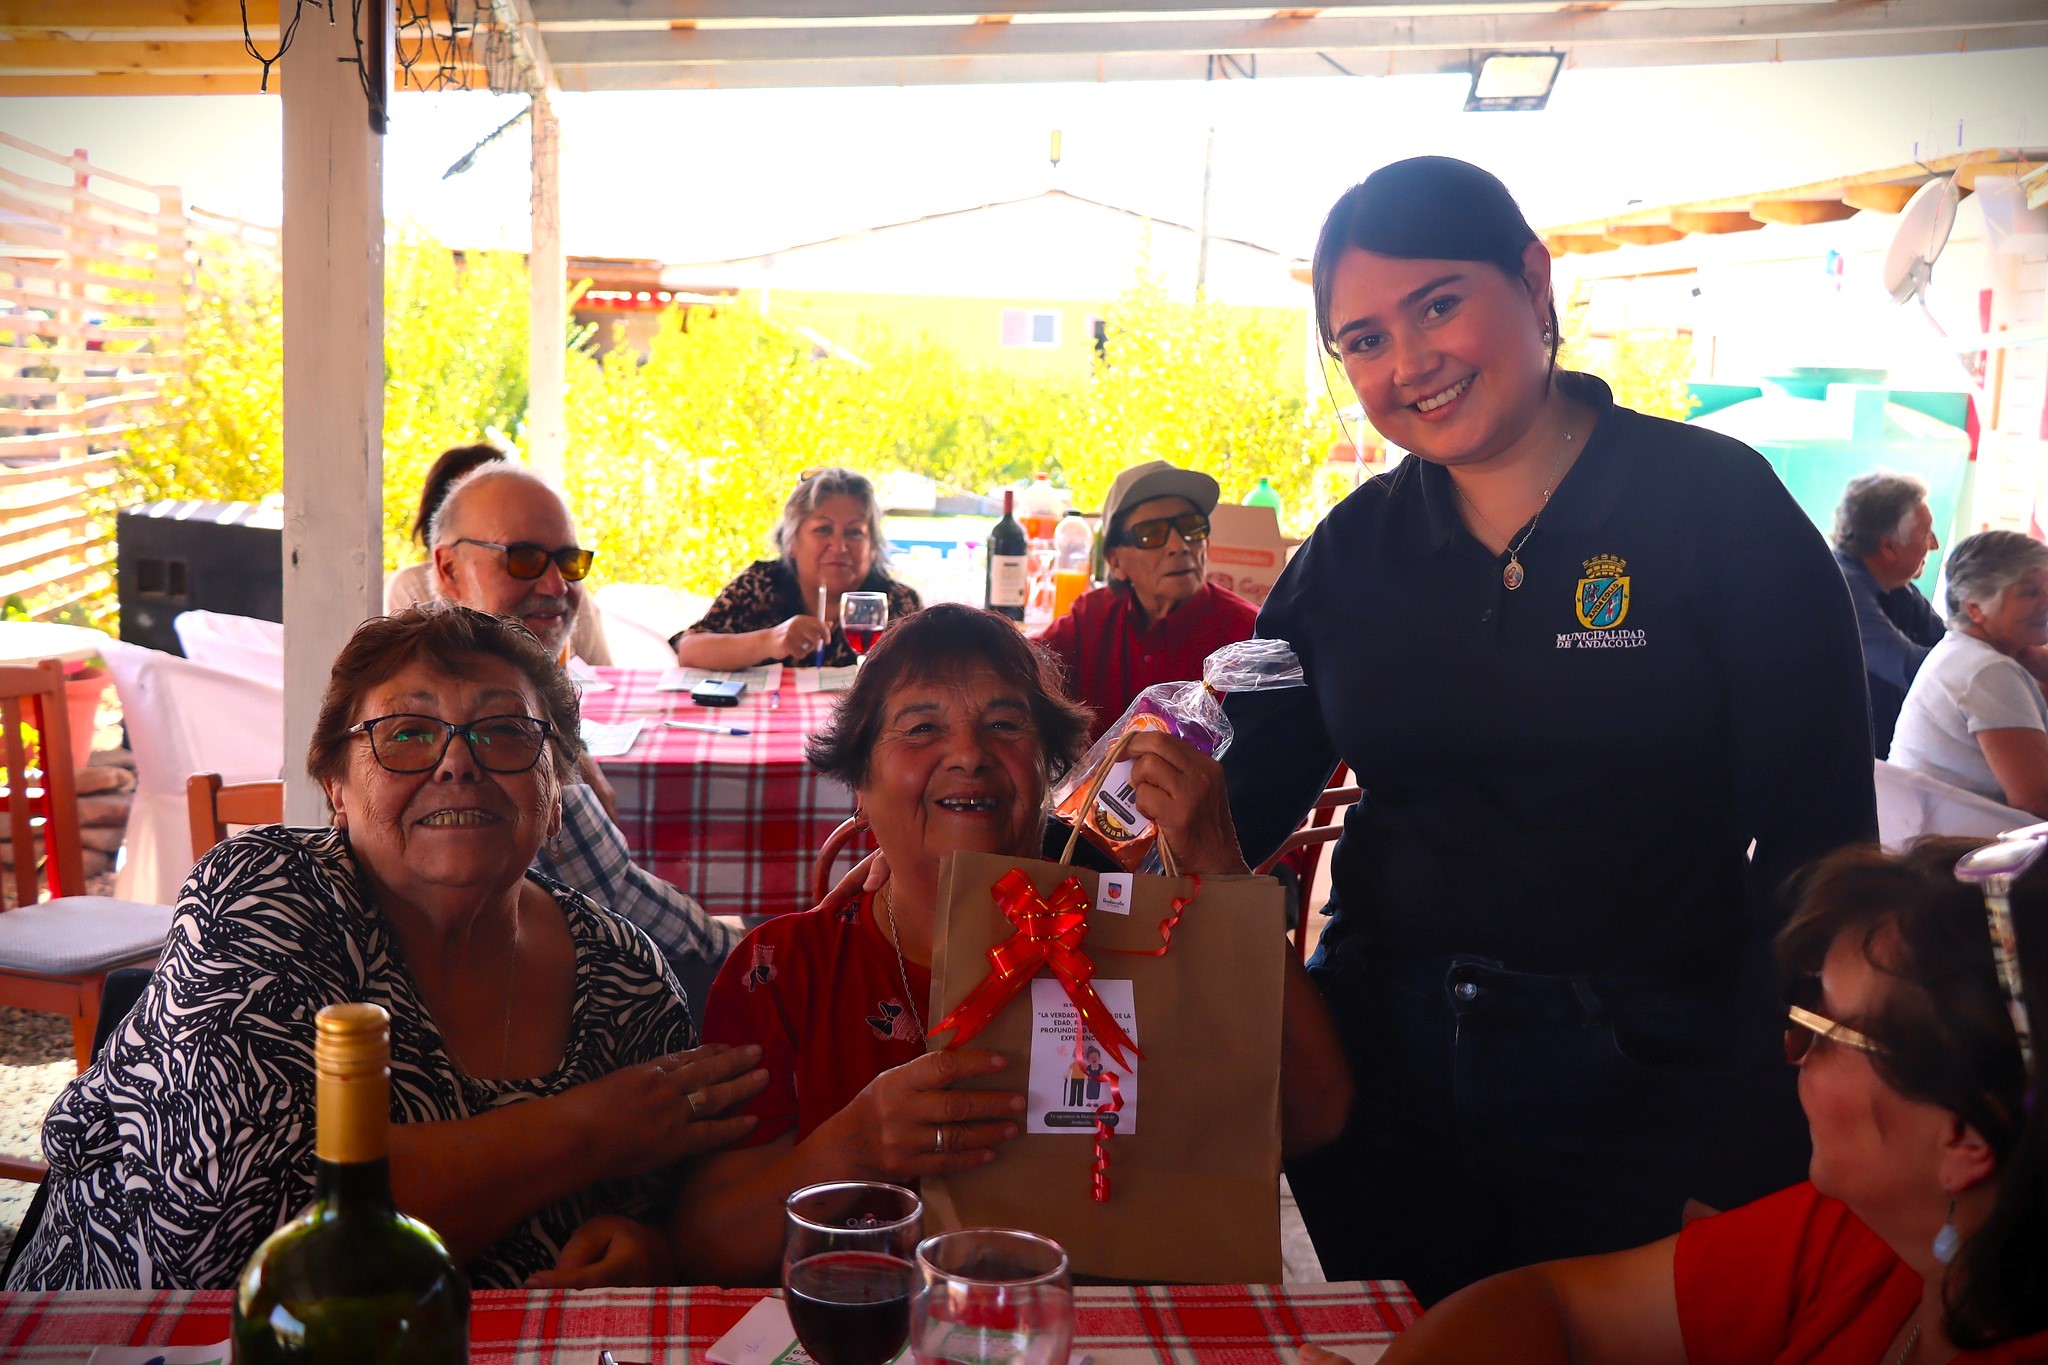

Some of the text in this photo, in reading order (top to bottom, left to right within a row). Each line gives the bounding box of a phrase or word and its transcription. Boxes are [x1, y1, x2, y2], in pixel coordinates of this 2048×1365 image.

[1556, 629, 1646, 642] MUNICIPALIDAD
[1556, 639, 1647, 649] DE ANDACOLLO
